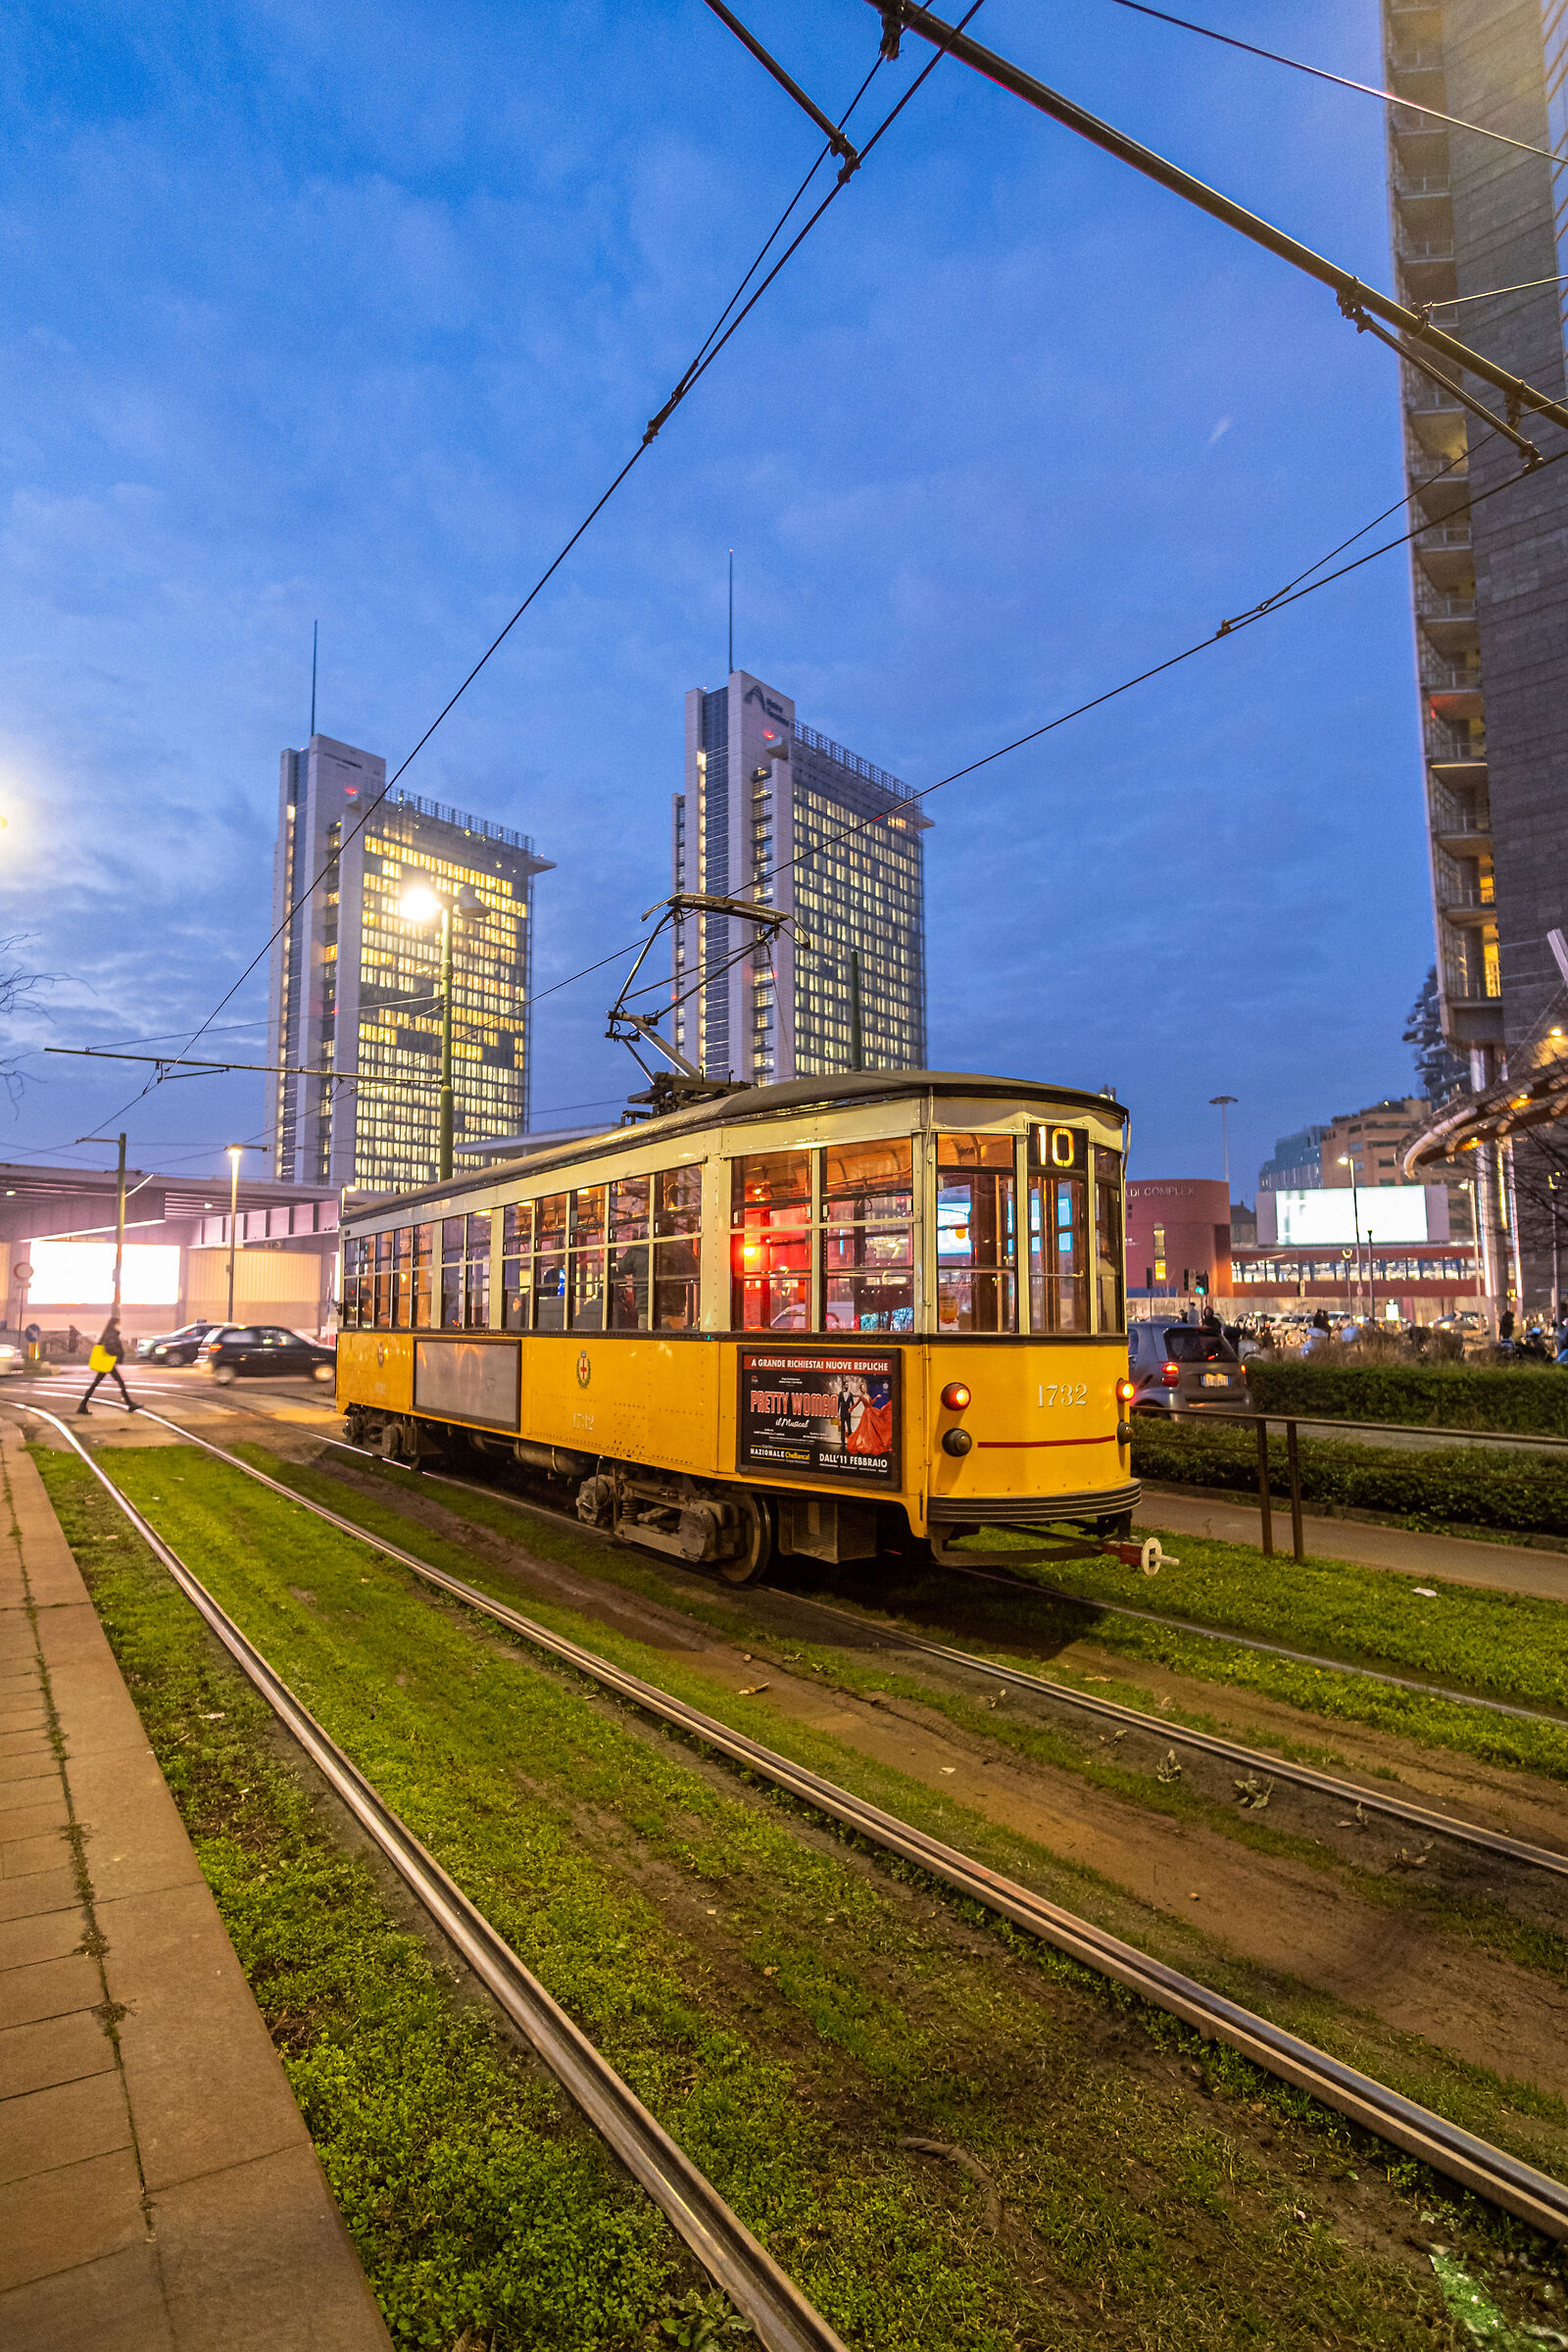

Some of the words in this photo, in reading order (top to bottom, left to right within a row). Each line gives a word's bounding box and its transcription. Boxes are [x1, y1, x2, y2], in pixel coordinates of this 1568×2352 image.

[1038, 1125, 1074, 1167] 10
[1144, 1185, 1194, 1196] COMPLEX
[751, 1358, 757, 1367] A
[758, 1359, 786, 1368] GRANDE
[787, 1360, 824, 1369] RICHIESTA!
[825, 1361, 852, 1370] NUOVE
[854, 1362, 888, 1371] REPLICHE
[1038, 1383, 1087, 1407] 1732
[751, 1390, 789, 1414] PRETTY
[791, 1393, 839, 1418] WOMAN
[781, 1418, 809, 1428] Musical
[751, 1447, 785, 1458] NAZIONALE
[850, 1456, 888, 1468] FEBBRAIO
